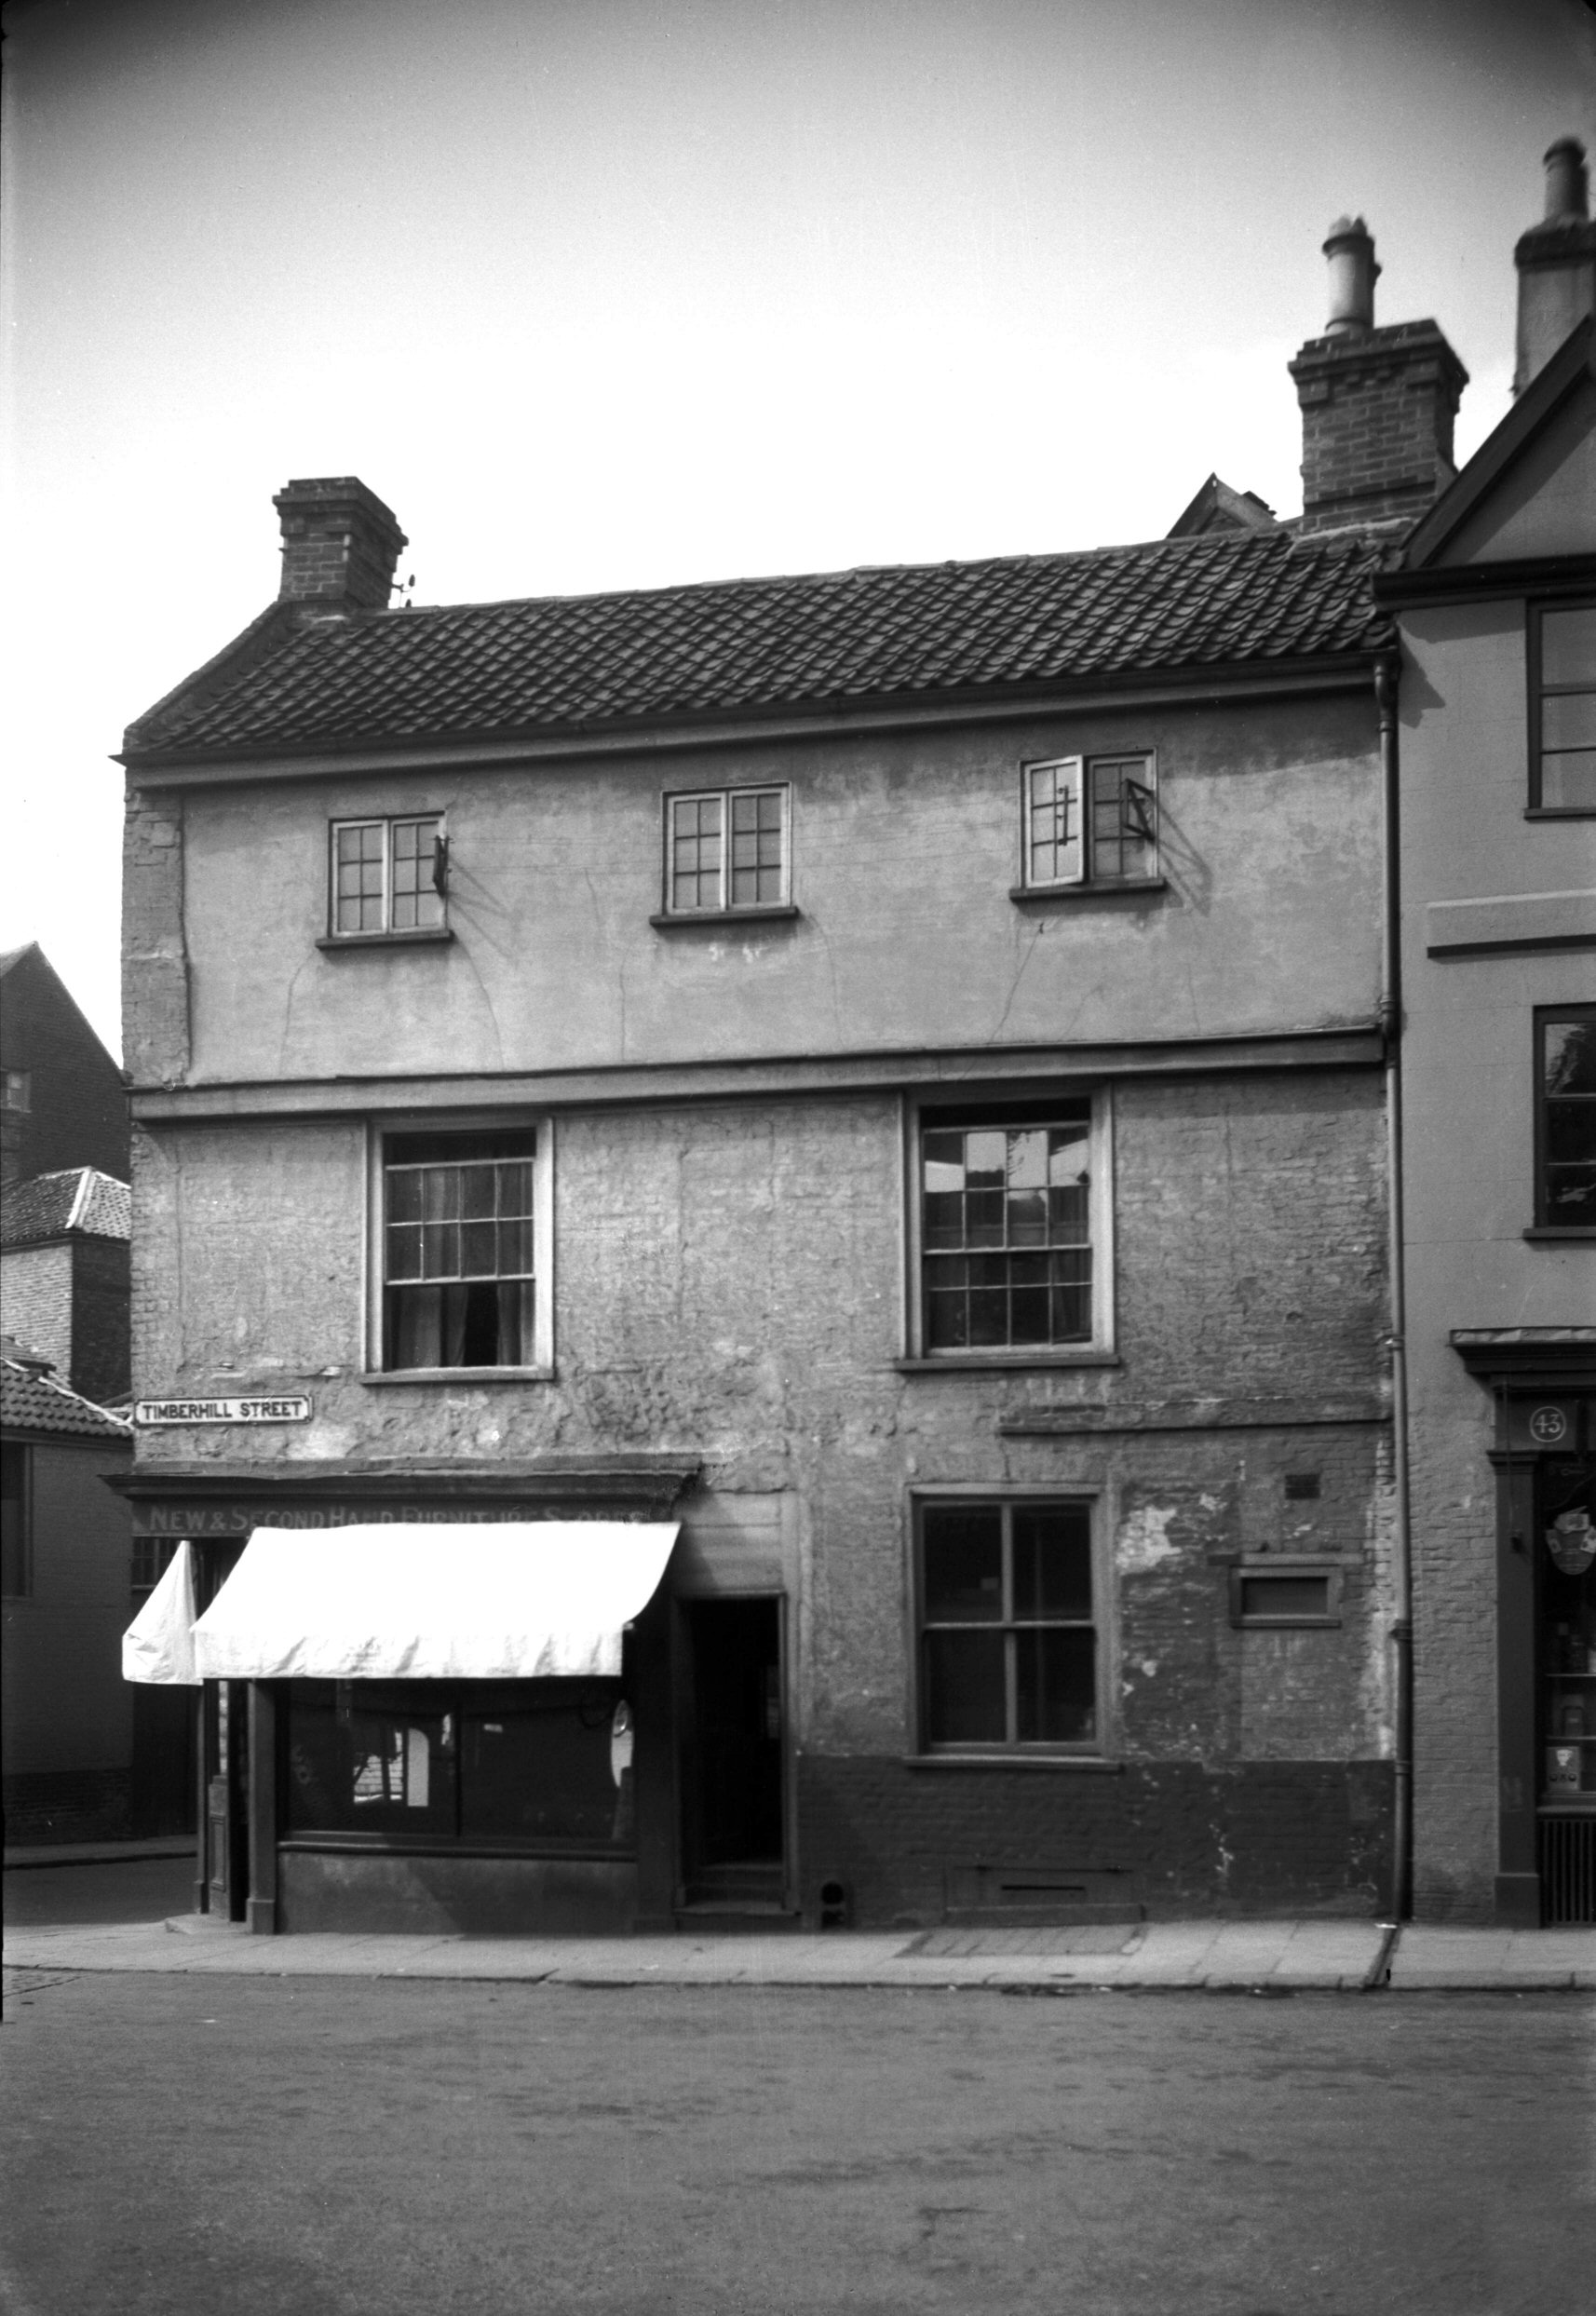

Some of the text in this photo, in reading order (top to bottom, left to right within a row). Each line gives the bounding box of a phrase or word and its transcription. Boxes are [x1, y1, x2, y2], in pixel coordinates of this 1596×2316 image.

[142, 1401, 303, 1419] TIMBERHILL STREET
[1535, 1414, 1562, 1434] 43
[149, 1506, 206, 1531] NEW
[210, 1510, 227, 1531] &
[231, 1507, 325, 1530] SECOND
